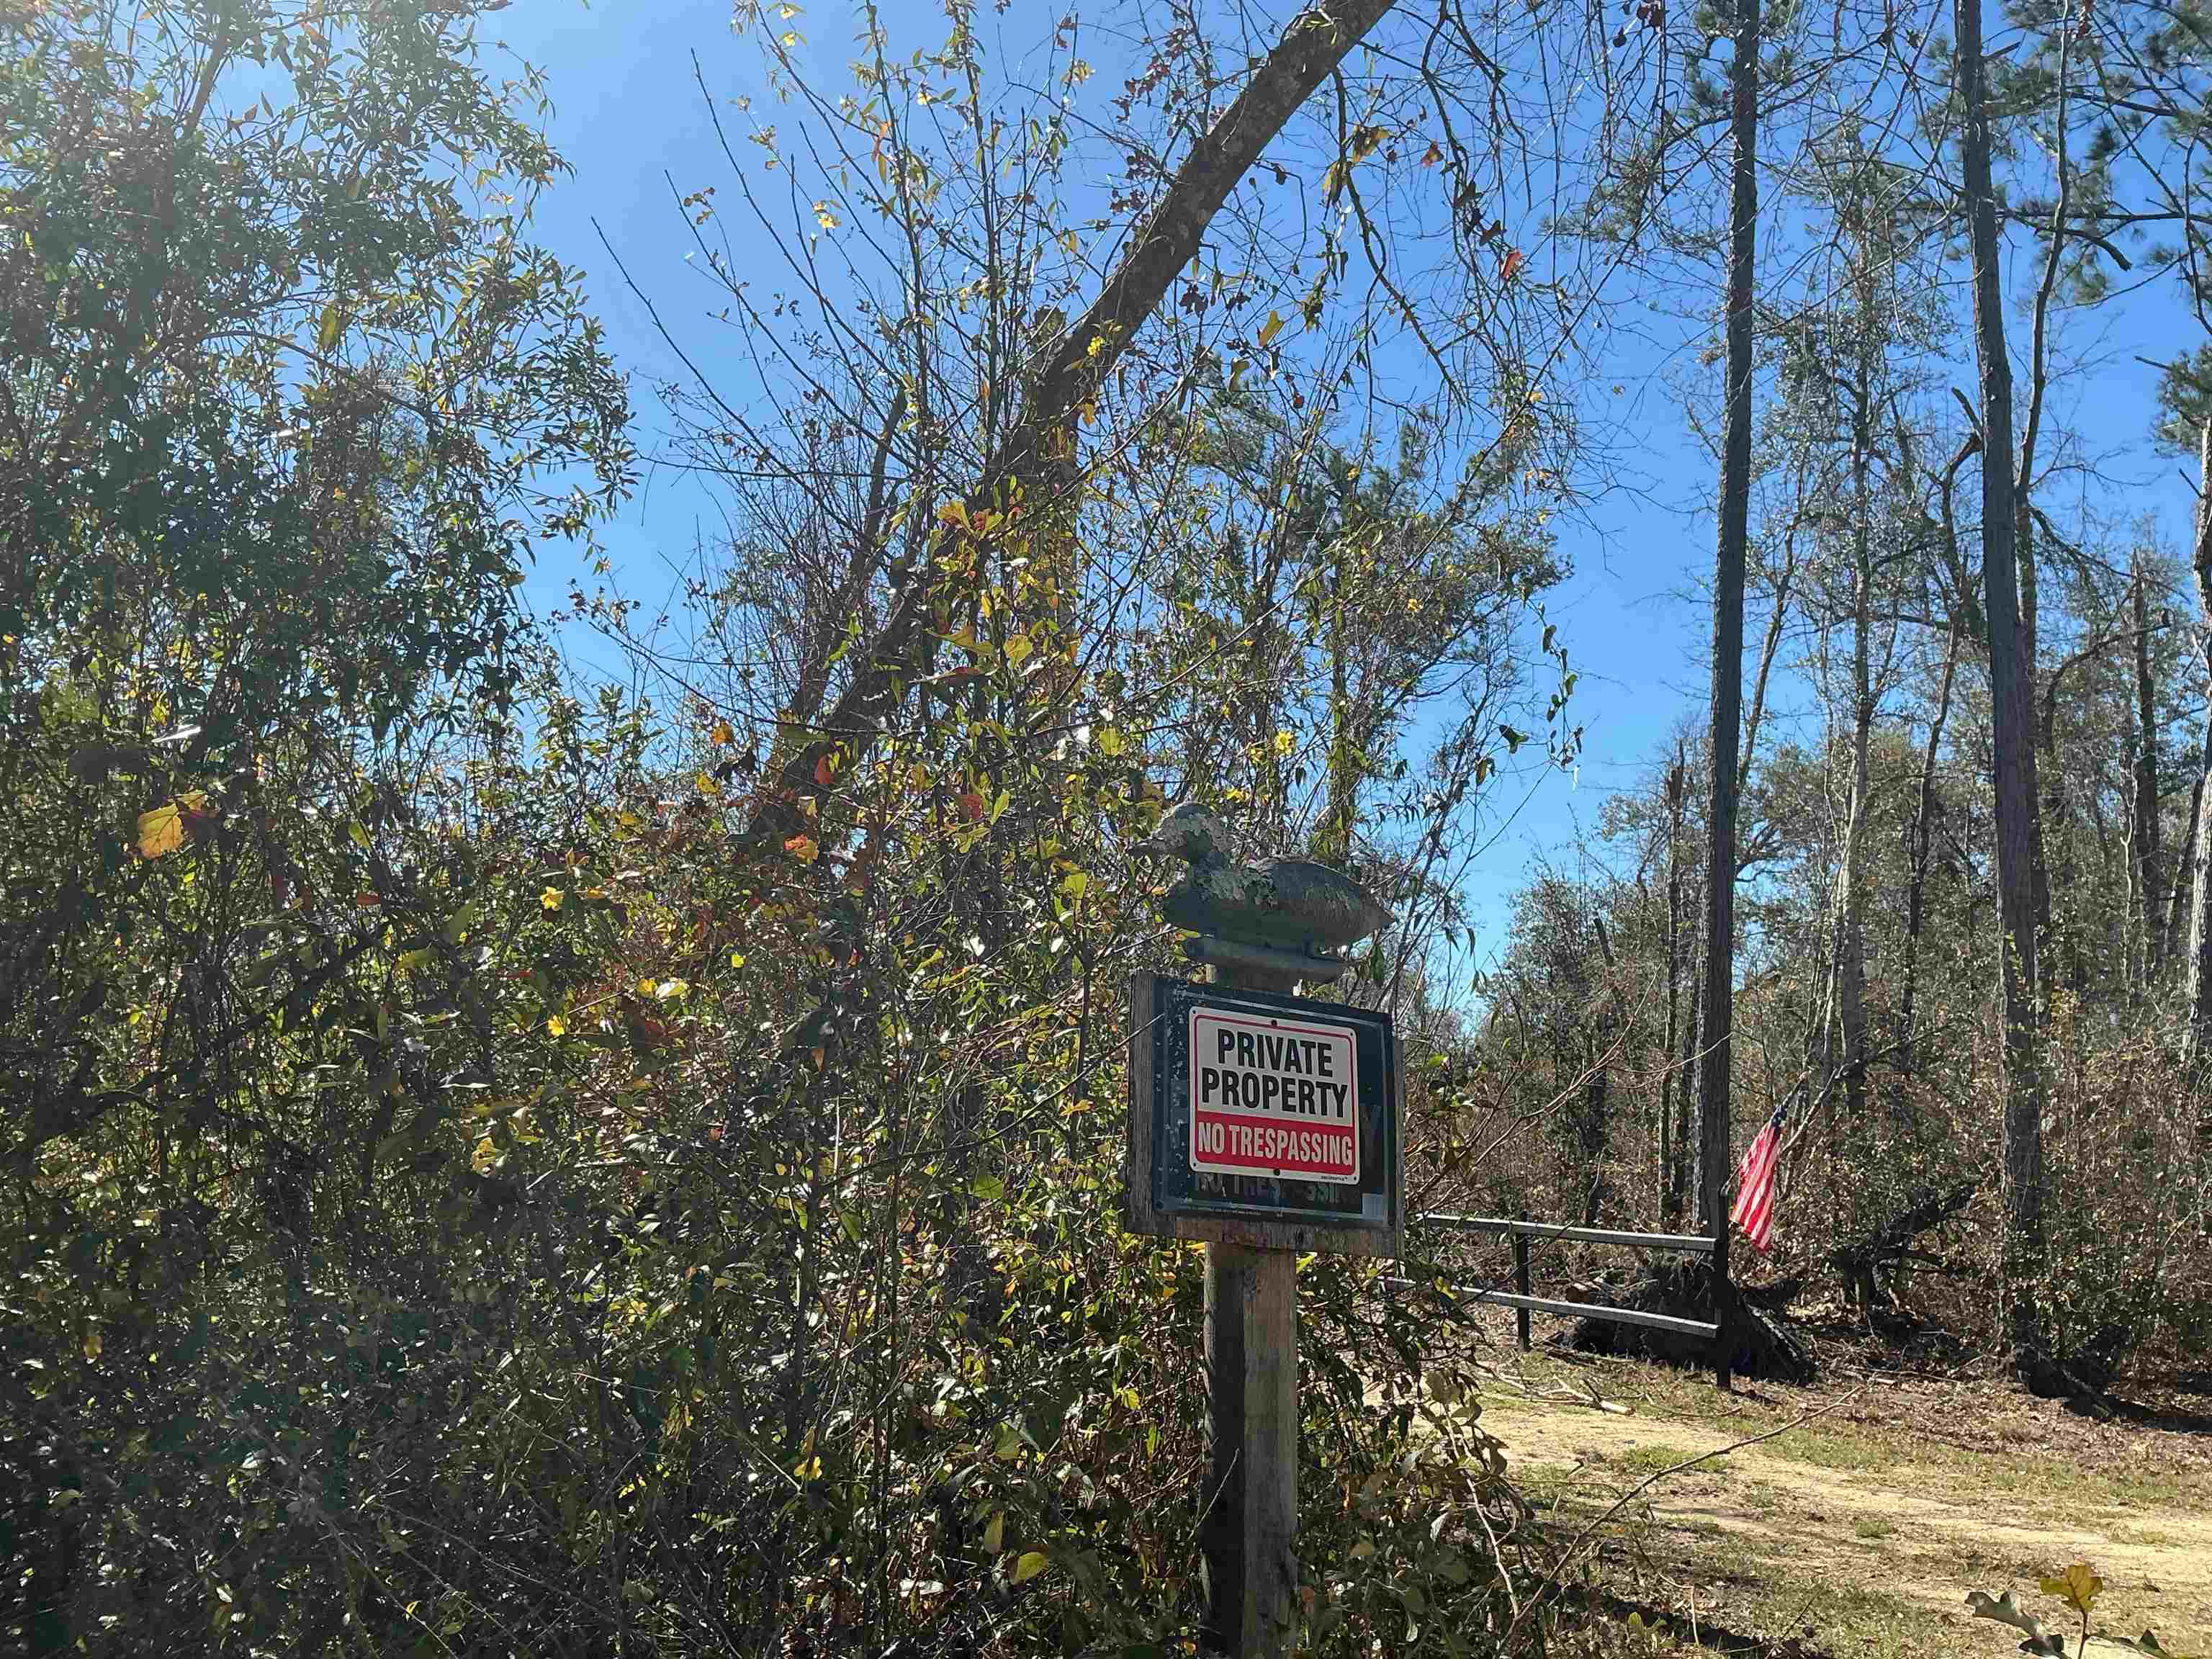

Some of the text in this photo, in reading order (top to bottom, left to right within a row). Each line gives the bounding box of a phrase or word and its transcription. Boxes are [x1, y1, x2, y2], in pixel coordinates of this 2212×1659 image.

[1218, 1028, 1332, 1077] PRIVATE
[1202, 1067, 1348, 1118] PROPERTY
[1197, 1122, 1352, 1165] NO TRESPASSING
